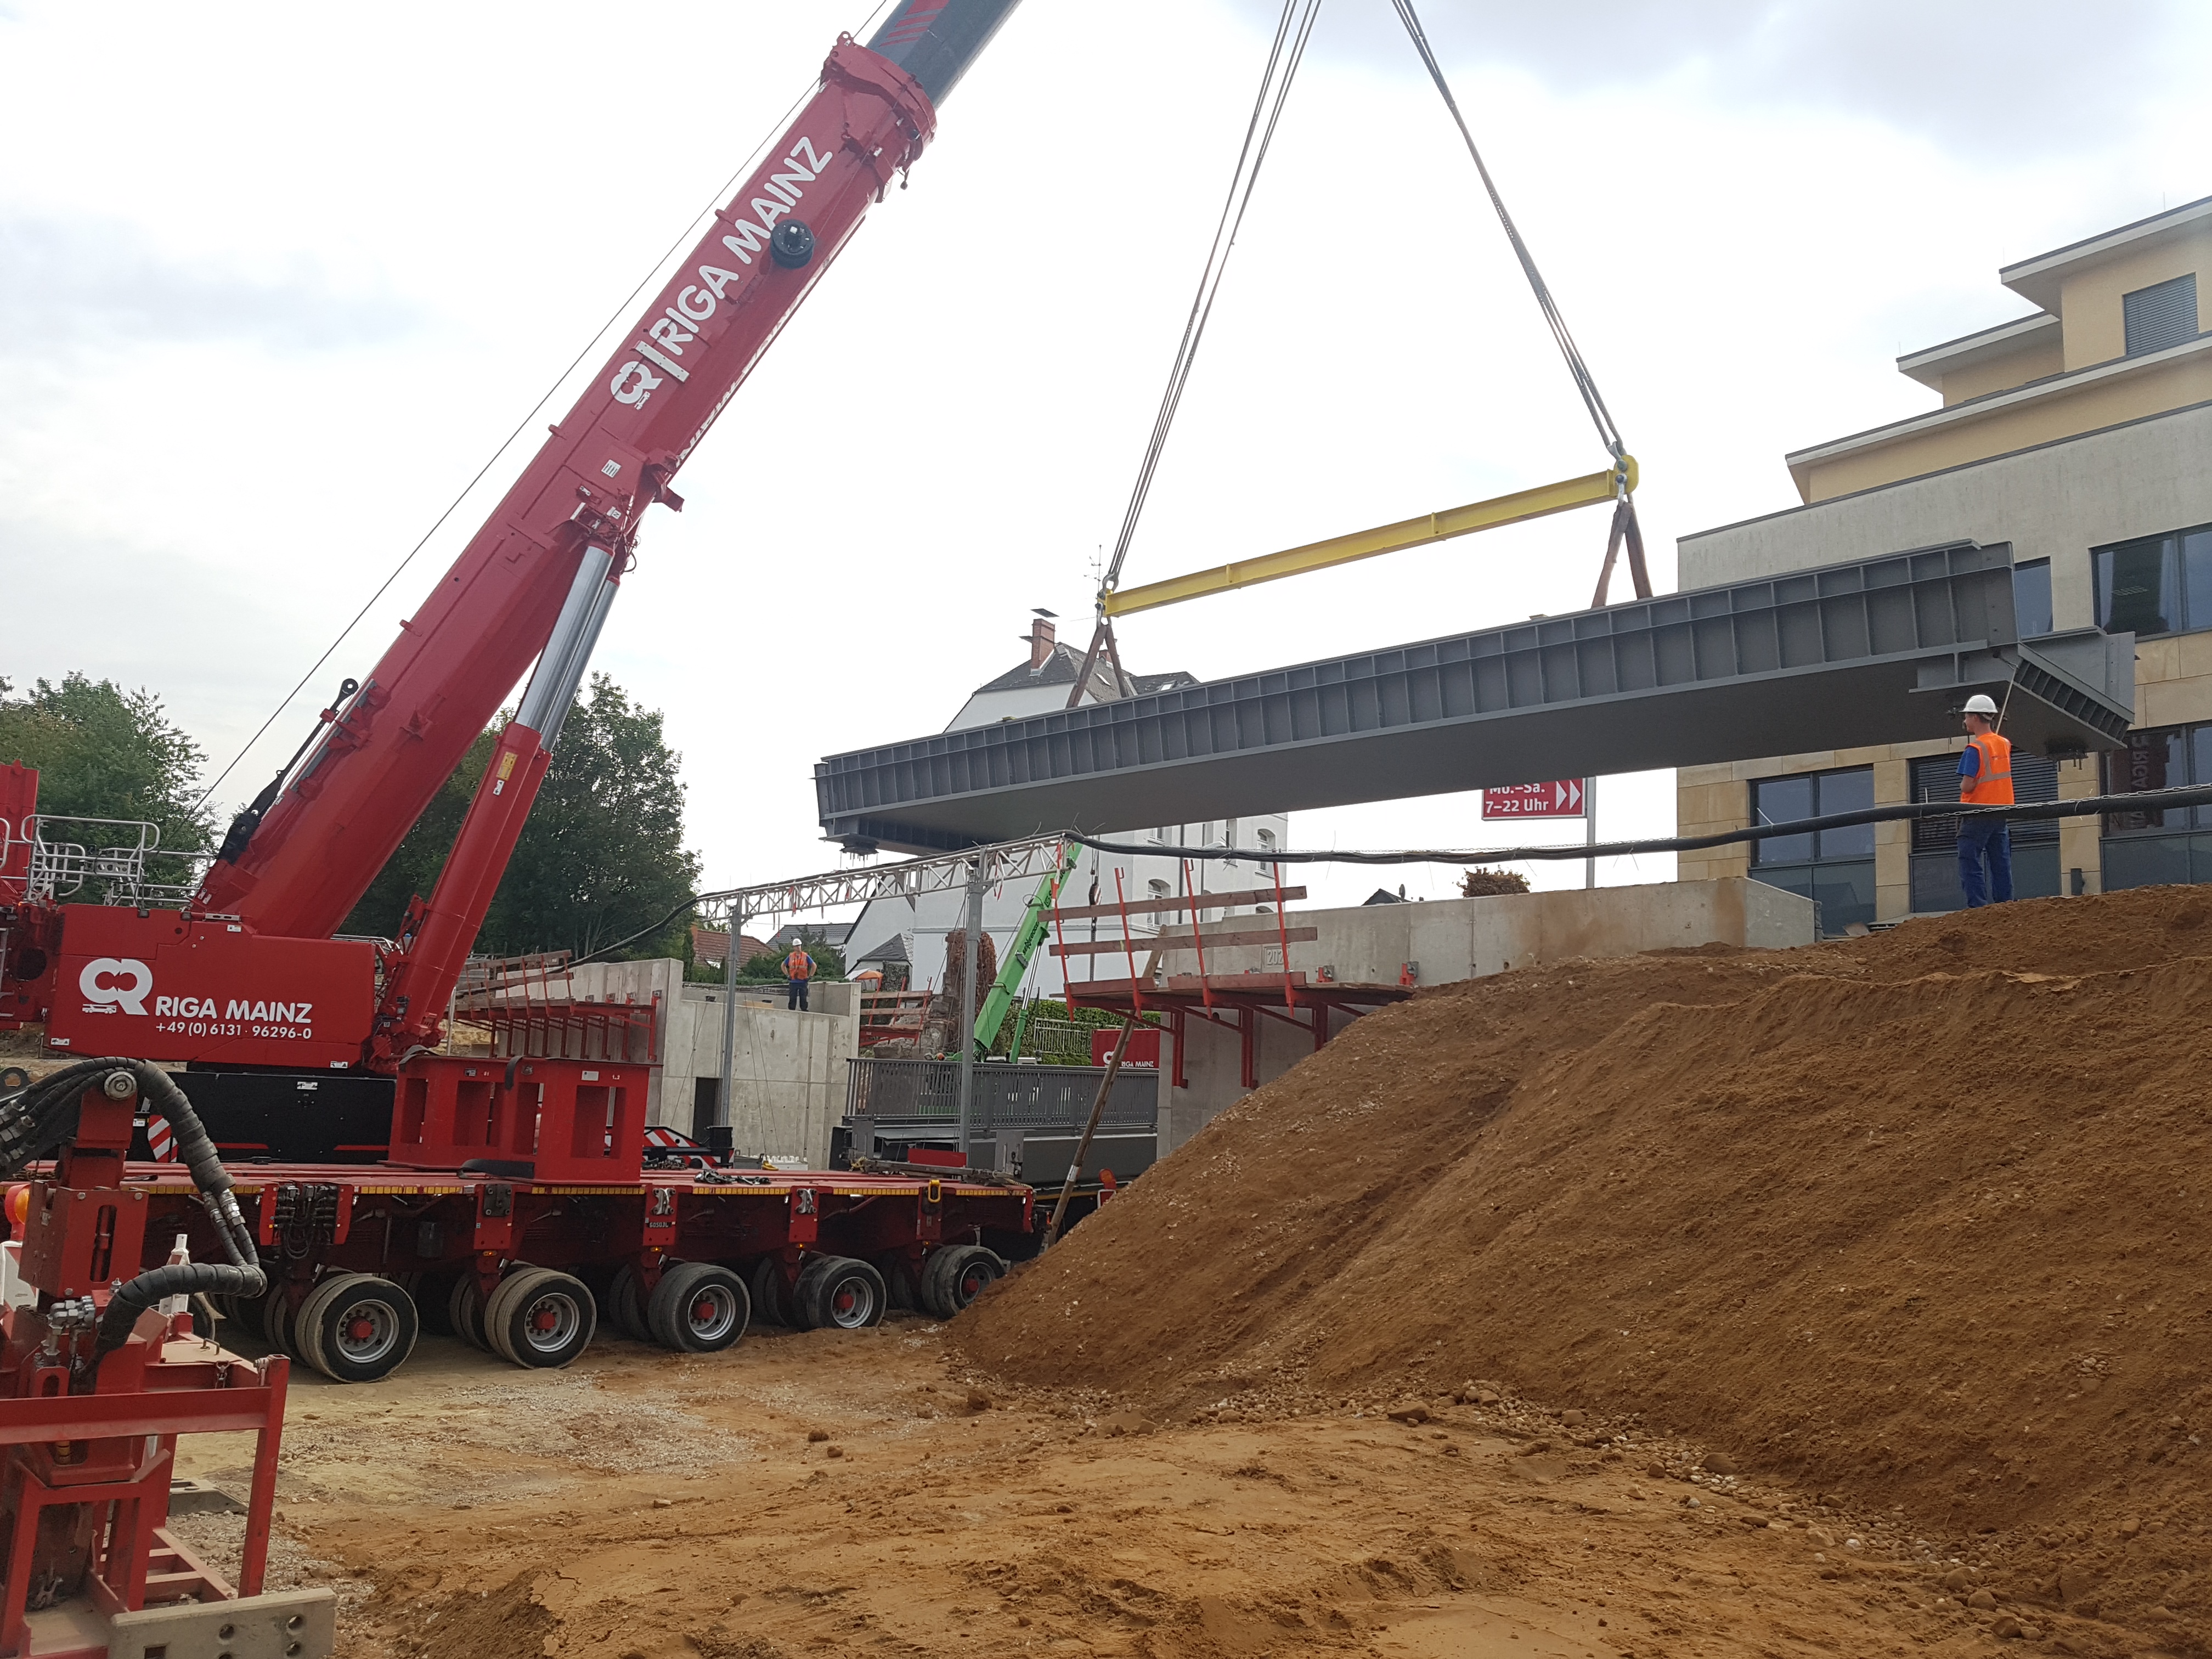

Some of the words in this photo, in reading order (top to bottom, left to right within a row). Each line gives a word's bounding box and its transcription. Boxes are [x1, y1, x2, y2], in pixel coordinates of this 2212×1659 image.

[649, 265, 739, 356] RIGA
[722, 136, 833, 264] MAINZ
[1524, 798, 1549, 811] Uhr
[1267, 950, 1289, 965] 202
[155, 996, 217, 1019] RIGA
[225, 1000, 312, 1023] MAINZ
[252, 1025, 312, 1039] 96296-0
